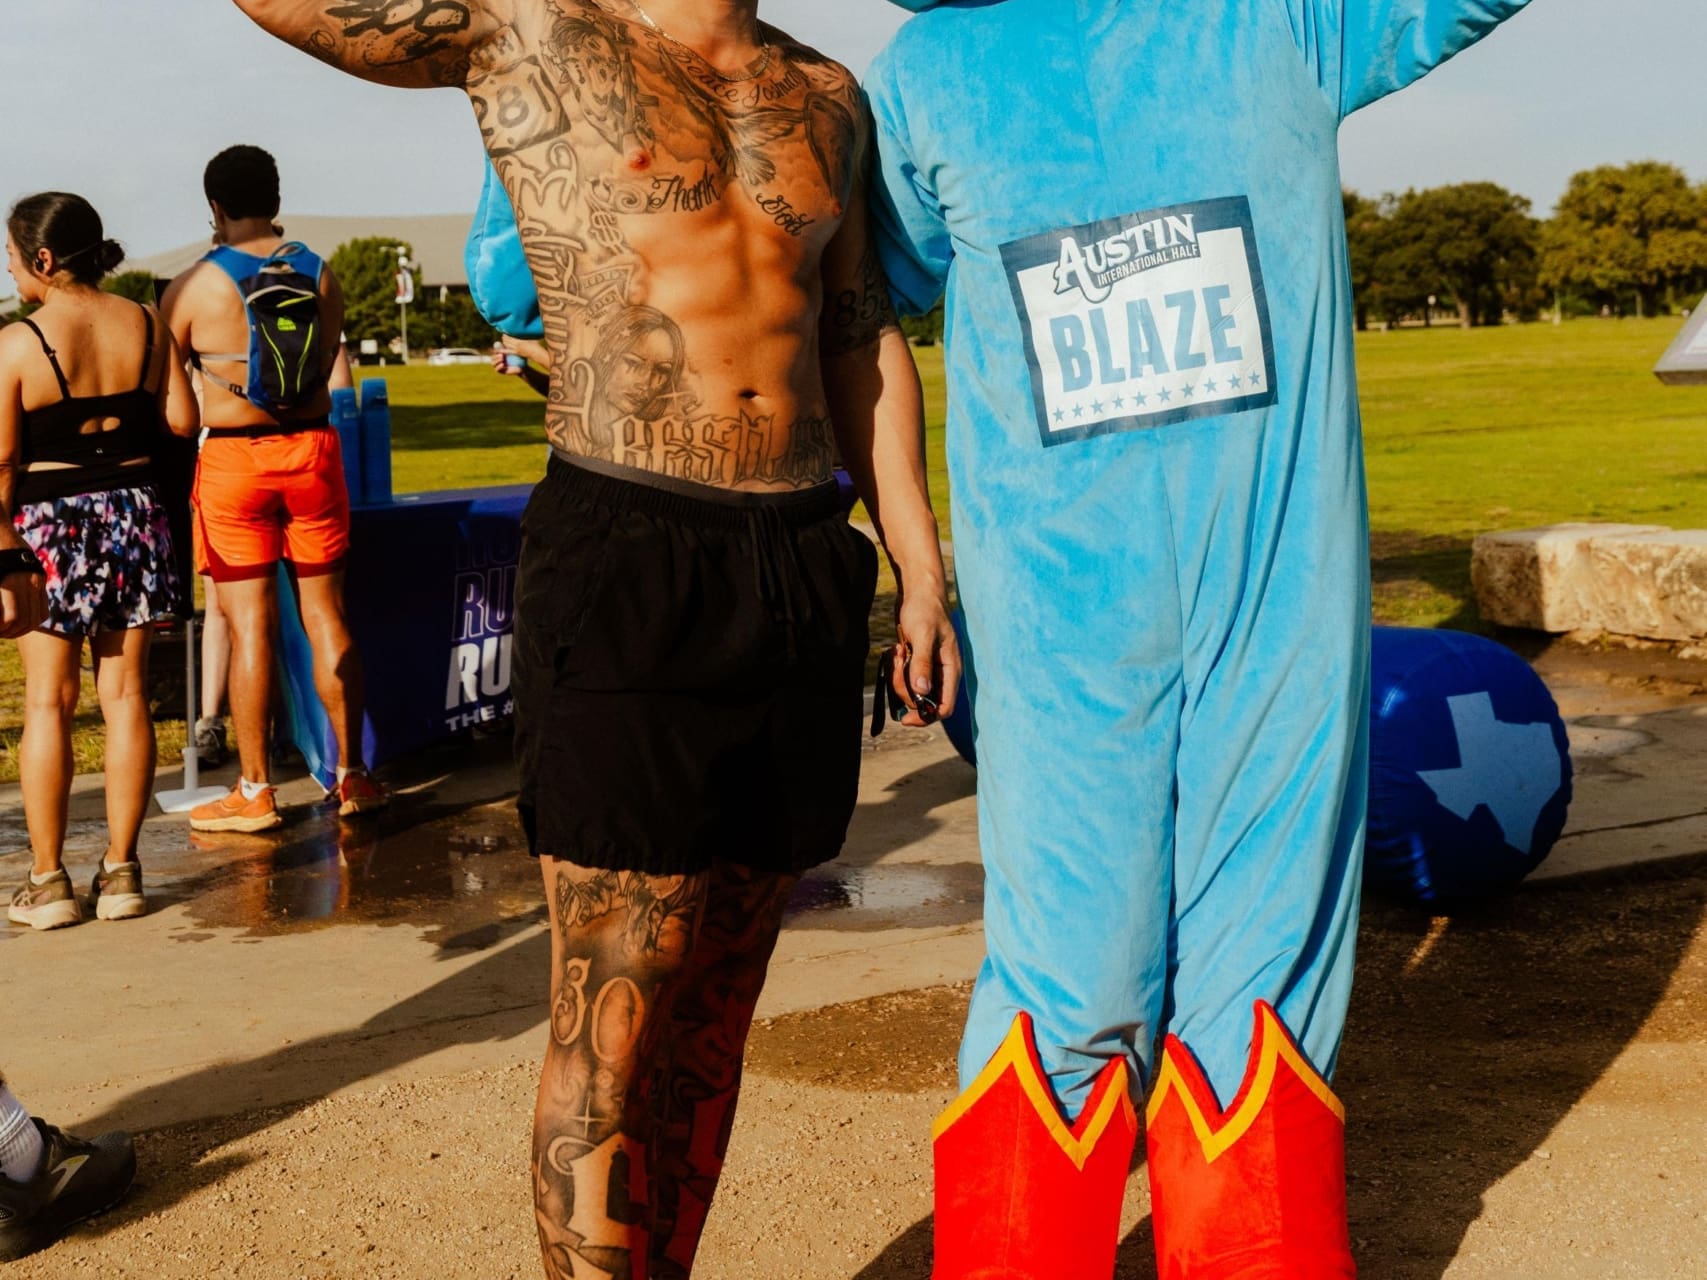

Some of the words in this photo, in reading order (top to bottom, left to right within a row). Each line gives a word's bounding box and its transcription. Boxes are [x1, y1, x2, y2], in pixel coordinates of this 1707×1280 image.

[650, 164, 721, 213] Thank
[755, 193, 816, 237] God
[1054, 213, 1197, 302] AUSTIN
[1097, 253, 1169, 287] INTERNATIONAL
[1172, 244, 1199, 260] HALF
[1049, 284, 1243, 394] BLAZE
[445, 704, 496, 732] THE
